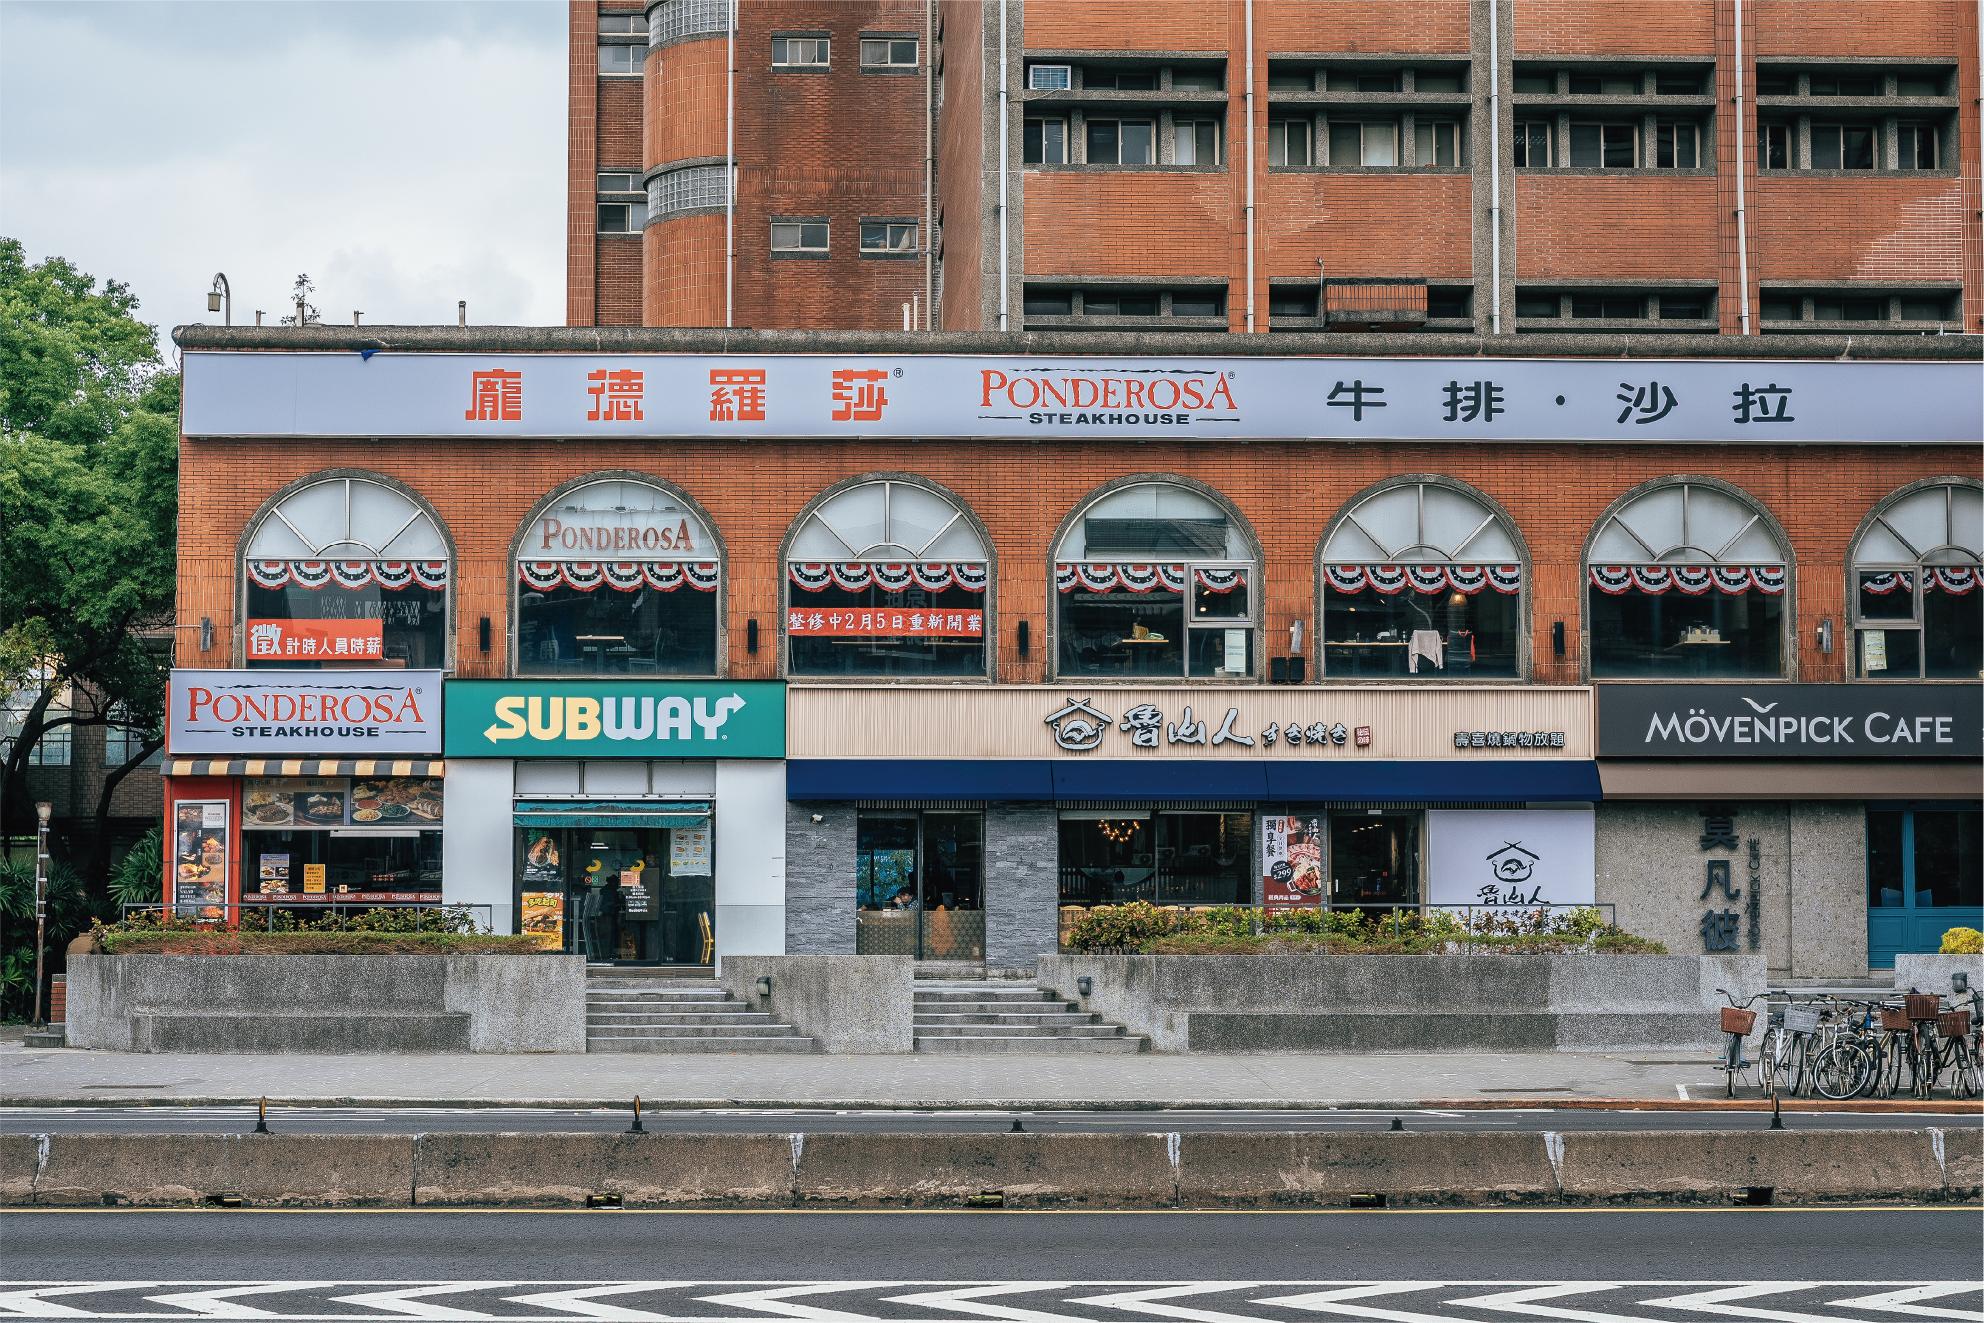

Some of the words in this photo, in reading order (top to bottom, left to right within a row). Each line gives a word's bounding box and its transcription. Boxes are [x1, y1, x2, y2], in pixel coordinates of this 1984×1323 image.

[465, 368, 889, 421] 龐德羅莎
[980, 368, 1238, 410] PONDEROSA
[1029, 412, 1190, 425] STEAKHOUSE
[540, 518, 695, 552] PONDEROSA
[788, 611, 982, 632] 整修中2月5日重新開業
[286, 637, 381, 655] 計時人員時薪
[187, 687, 424, 723] PONDEROSA
[483, 692, 747, 745] SUBWAY
[232, 726, 380, 737] STEAKHOUSE
[1119, 703, 1256, 749] 魯山人
[1454, 731, 1566, 747] 壽喜燒鍋物放題
[1644, 708, 1855, 743] MÖVENPICK
[1864, 711, 1954, 743] CAFE
